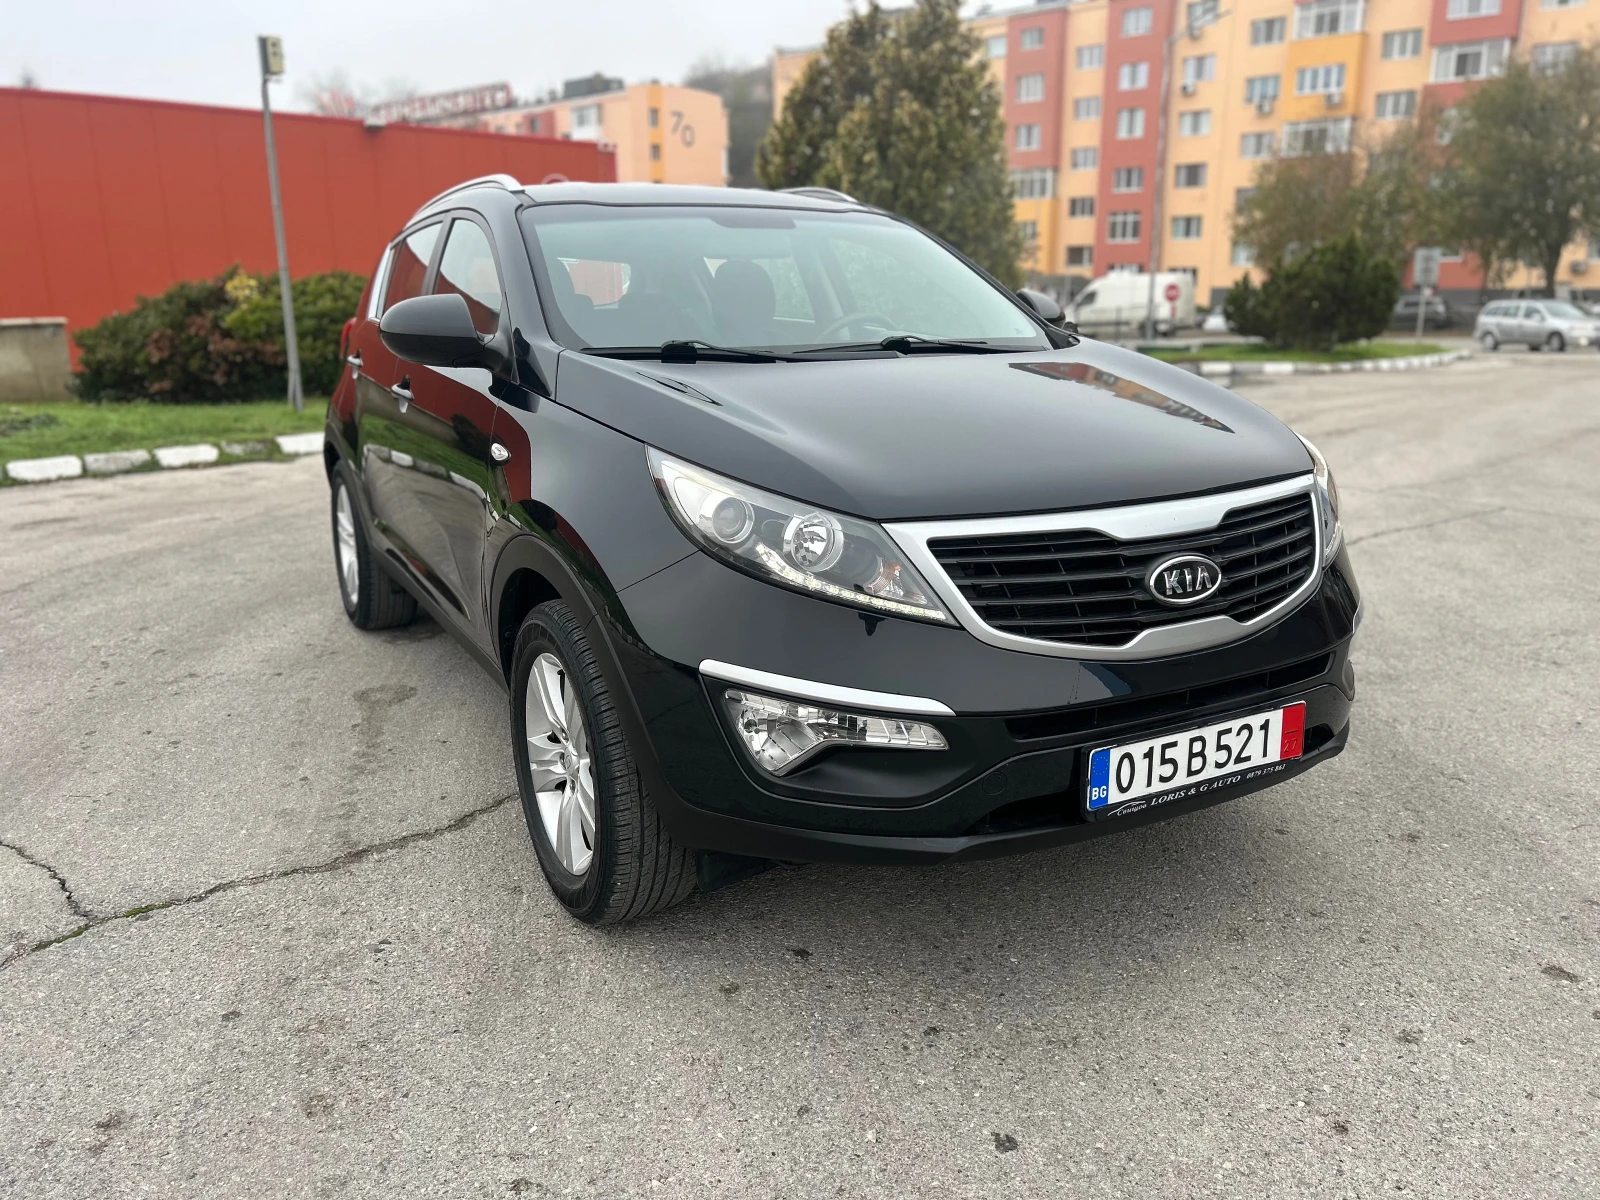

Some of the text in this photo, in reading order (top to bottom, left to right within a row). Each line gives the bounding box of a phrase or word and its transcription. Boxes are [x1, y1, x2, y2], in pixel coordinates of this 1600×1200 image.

[670, 110, 696, 149] 70
[1163, 565, 1213, 596] KIA
[1283, 737, 1298, 753] 27
[1091, 785, 1108, 801] BG
[1150, 789, 1187, 806] LORIS
[1187, 787, 1197, 796] &
[1209, 775, 1241, 790] AUTO
